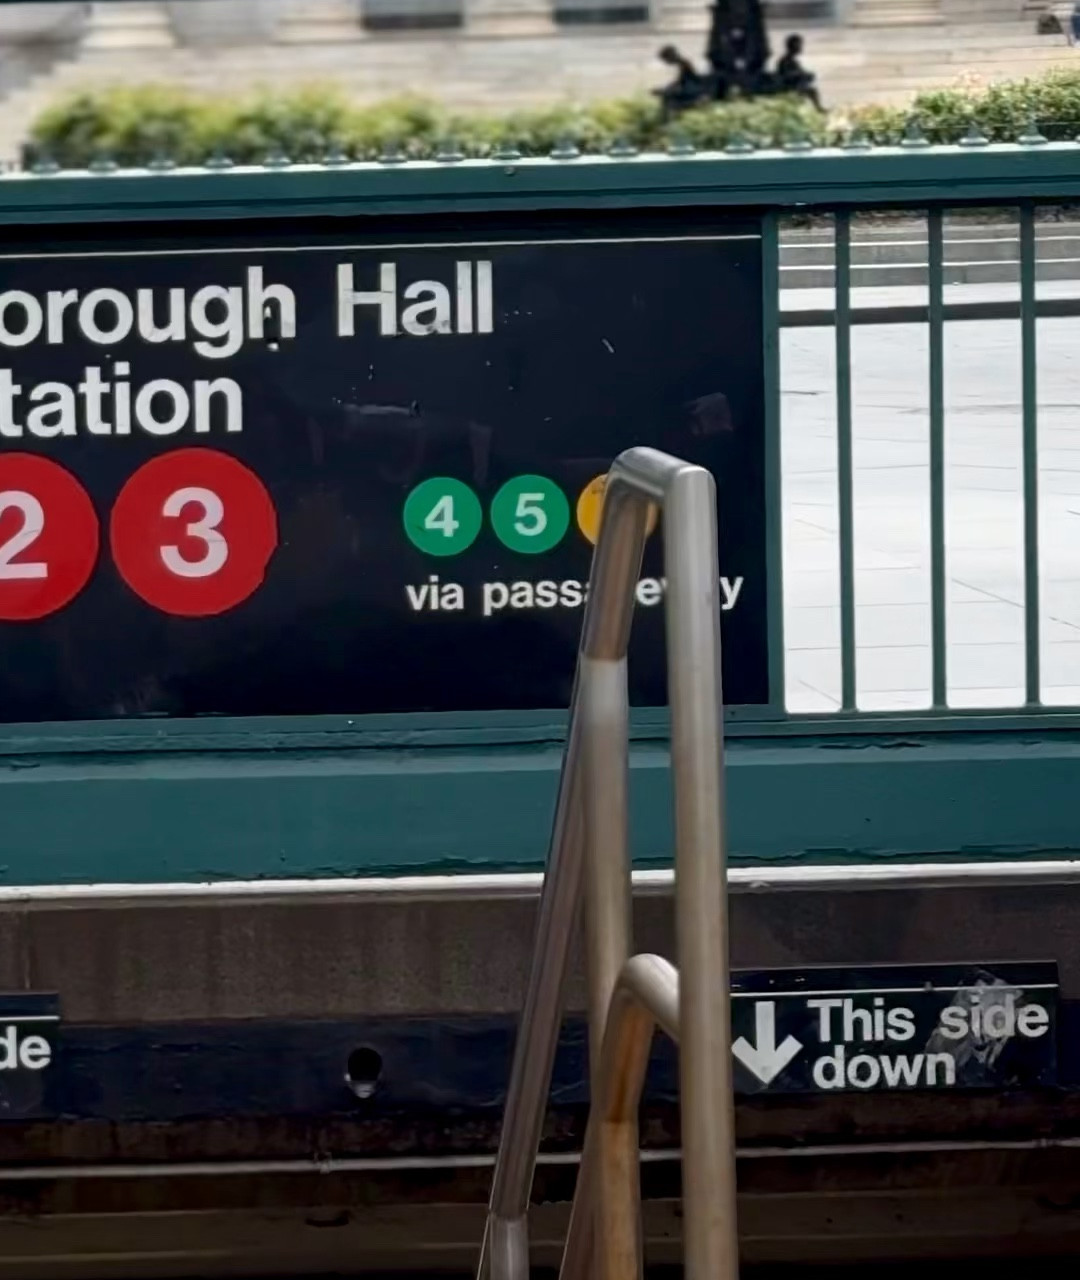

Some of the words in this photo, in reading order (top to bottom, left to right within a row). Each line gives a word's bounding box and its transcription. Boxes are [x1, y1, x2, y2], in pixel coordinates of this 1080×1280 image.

[337, 261, 494, 337] Hall
[160, 486, 229, 578] 3
[425, 495, 460, 538] 4
[514, 494, 547, 536] 5
[406, 576, 465, 611] via
[483, 575, 744, 616] passey
[806, 996, 915, 1043] This
[939, 991, 1050, 1038] side
[812, 1045, 956, 1089] down
